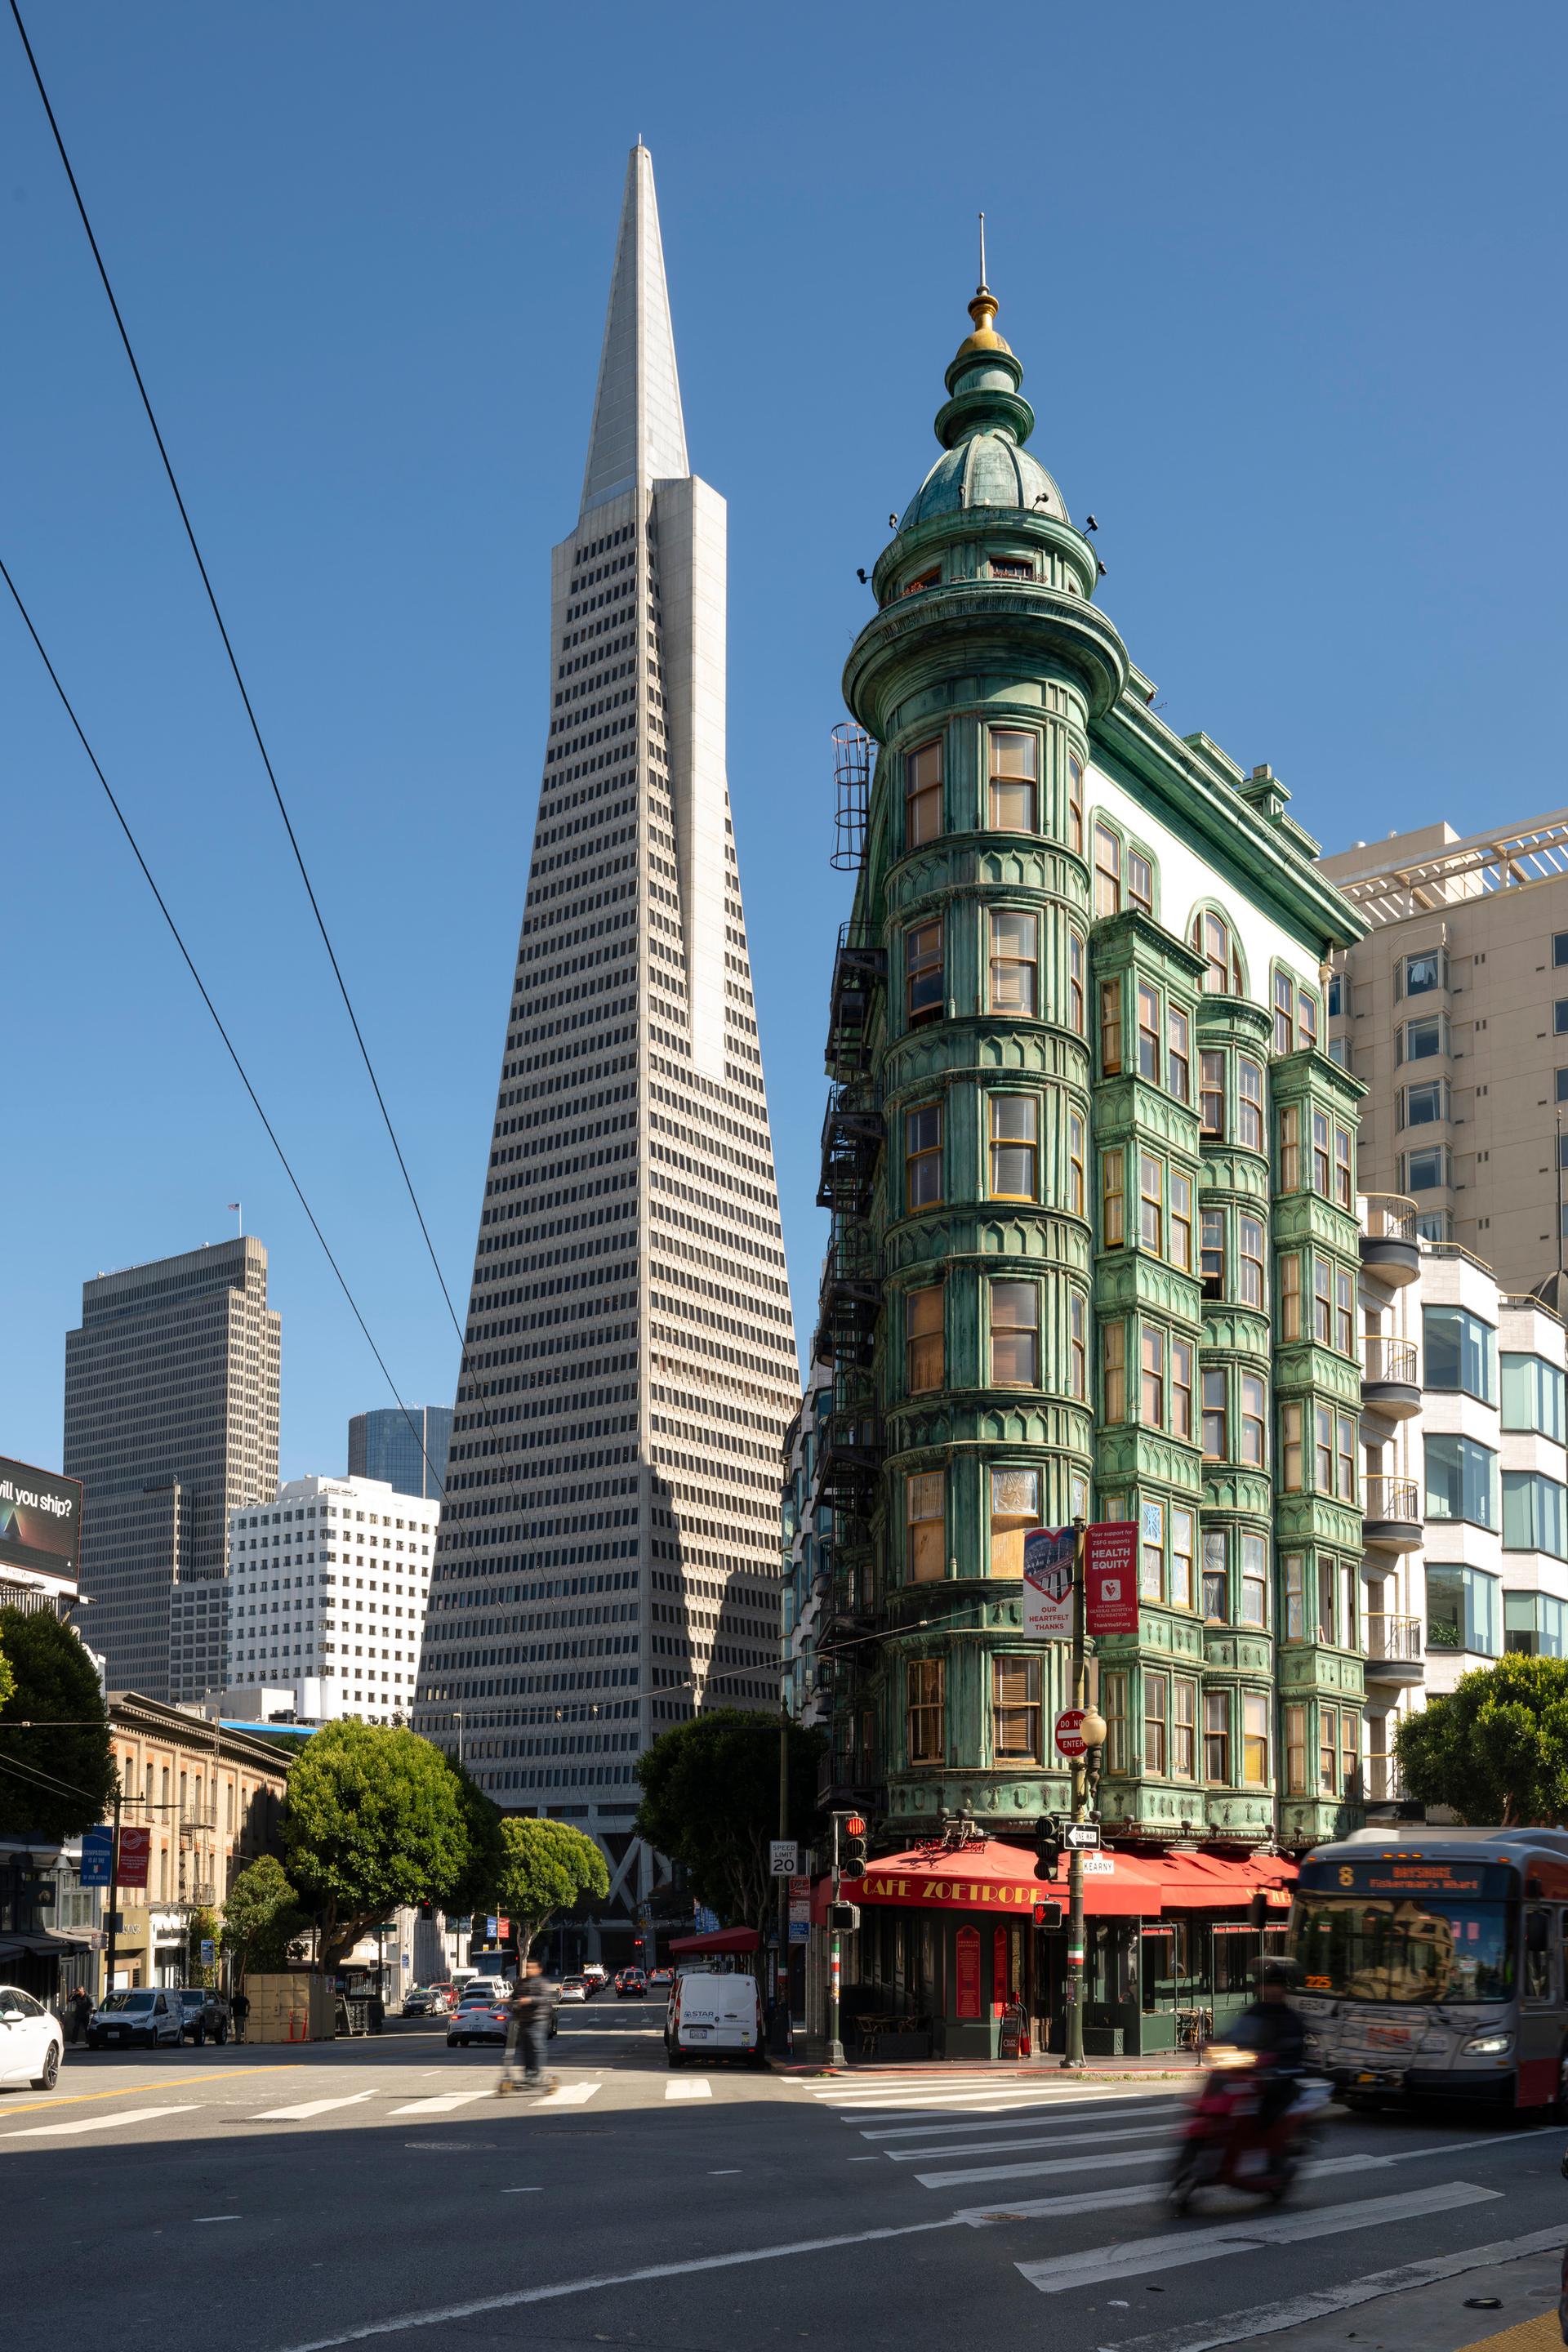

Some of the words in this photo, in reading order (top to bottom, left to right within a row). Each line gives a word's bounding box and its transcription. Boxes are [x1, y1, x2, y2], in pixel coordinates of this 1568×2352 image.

[15, 1487, 38, 1508] you
[39, 1493, 73, 1518] ship?
[1091, 1548, 1130, 1558] HEALTH
[1092, 1559, 1129, 1570] EQUITY
[1029, 1615, 1069, 1623] HEARTFELT
[1060, 1720, 1070, 1728] DO
[1073, 1719, 1082, 1727] NO
[1062, 1740, 1085, 1748] ENTER
[1076, 1832, 1085, 1841] ONE
[1085, 1833, 1095, 1842] WAY
[773, 1859, 795, 1872] 20
[1084, 1862, 1112, 1871] KEARNY
[1338, 1866, 1355, 1886] 8
[1369, 1878, 1438, 1889] Fisherman's
[1442, 1879, 1479, 1889] Wharf
[862, 1878, 911, 1896] CAFE
[922, 1881, 1042, 1904] ZOETROPE
